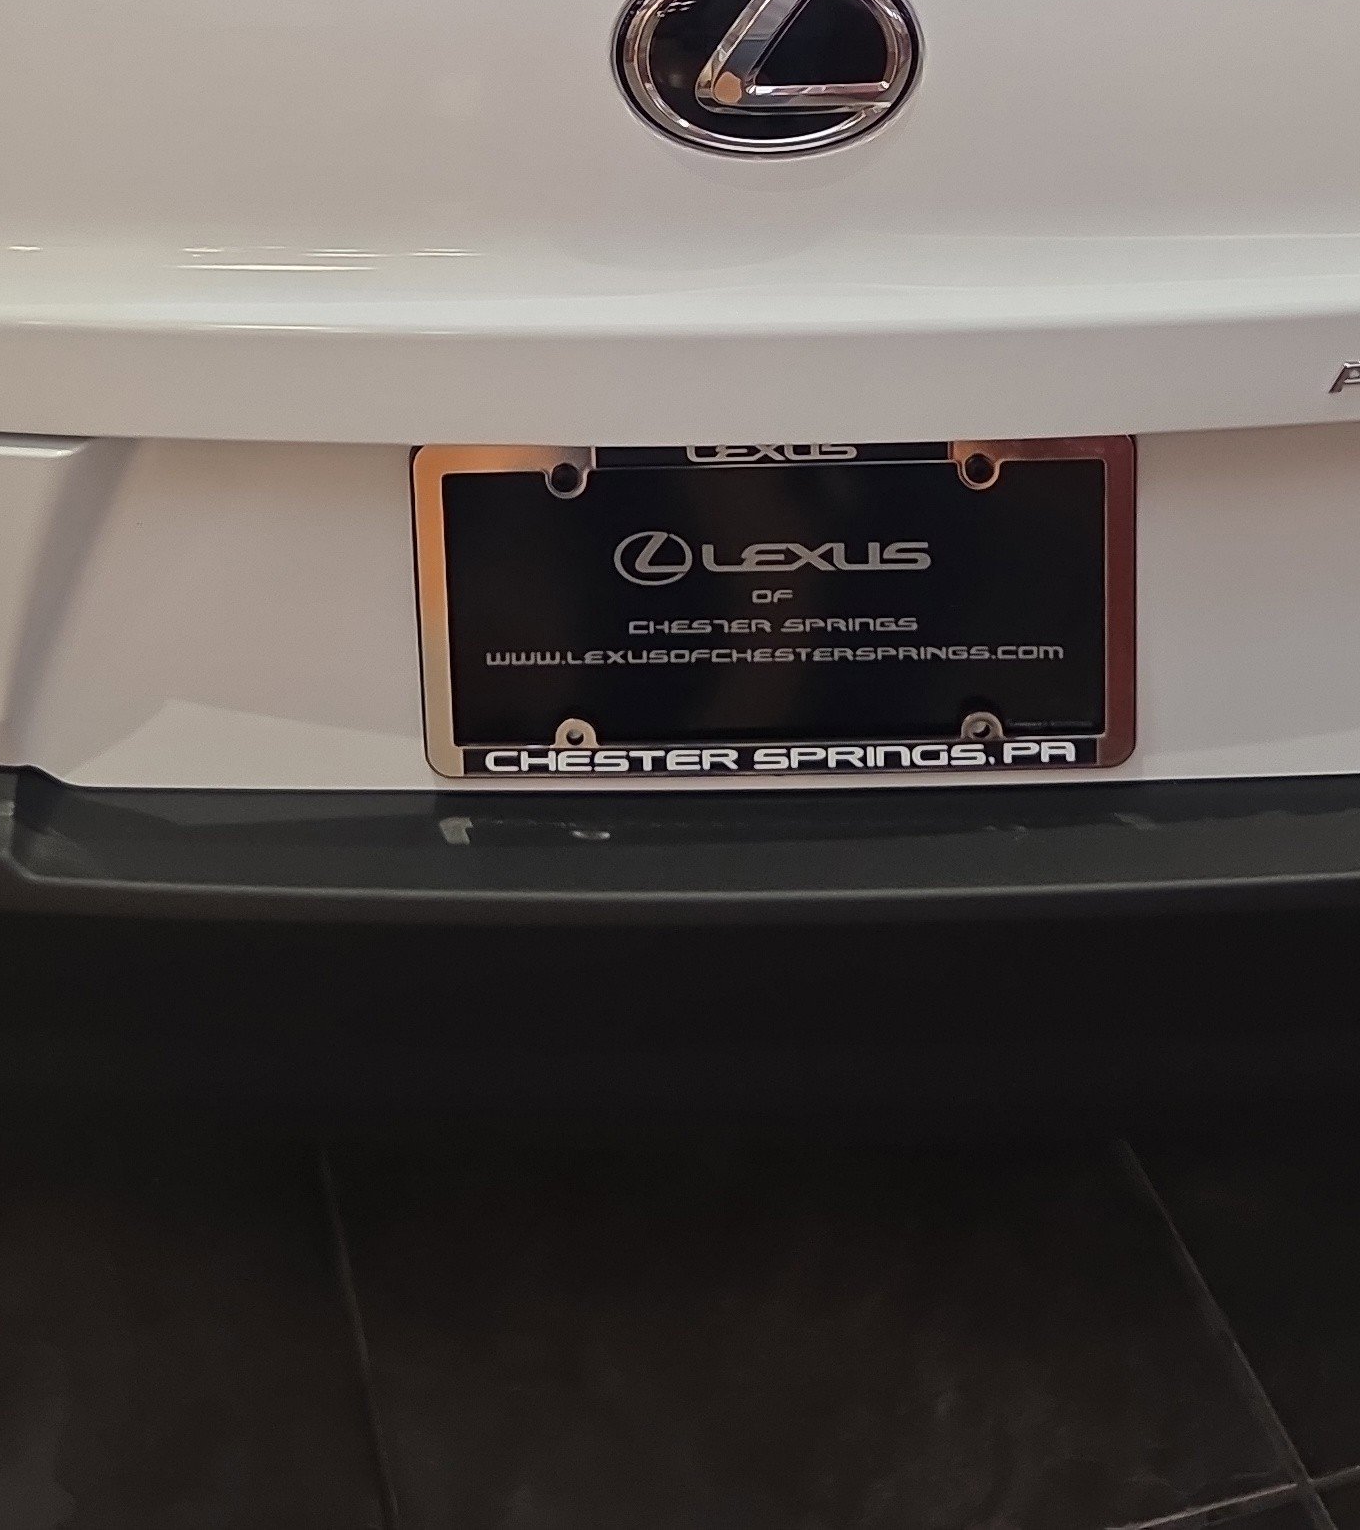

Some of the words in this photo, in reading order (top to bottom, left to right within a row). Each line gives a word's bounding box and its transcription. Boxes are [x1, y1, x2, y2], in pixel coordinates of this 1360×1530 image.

[686, 443, 857, 463] LEXUS
[701, 541, 932, 572] LEXUS
[751, 588, 794, 604] OF
[628, 619, 772, 635] CHESTER
[779, 617, 919, 633] SPRINGS
[485, 748, 739, 772] CHESTER
[1002, 740, 1077, 764] PA
